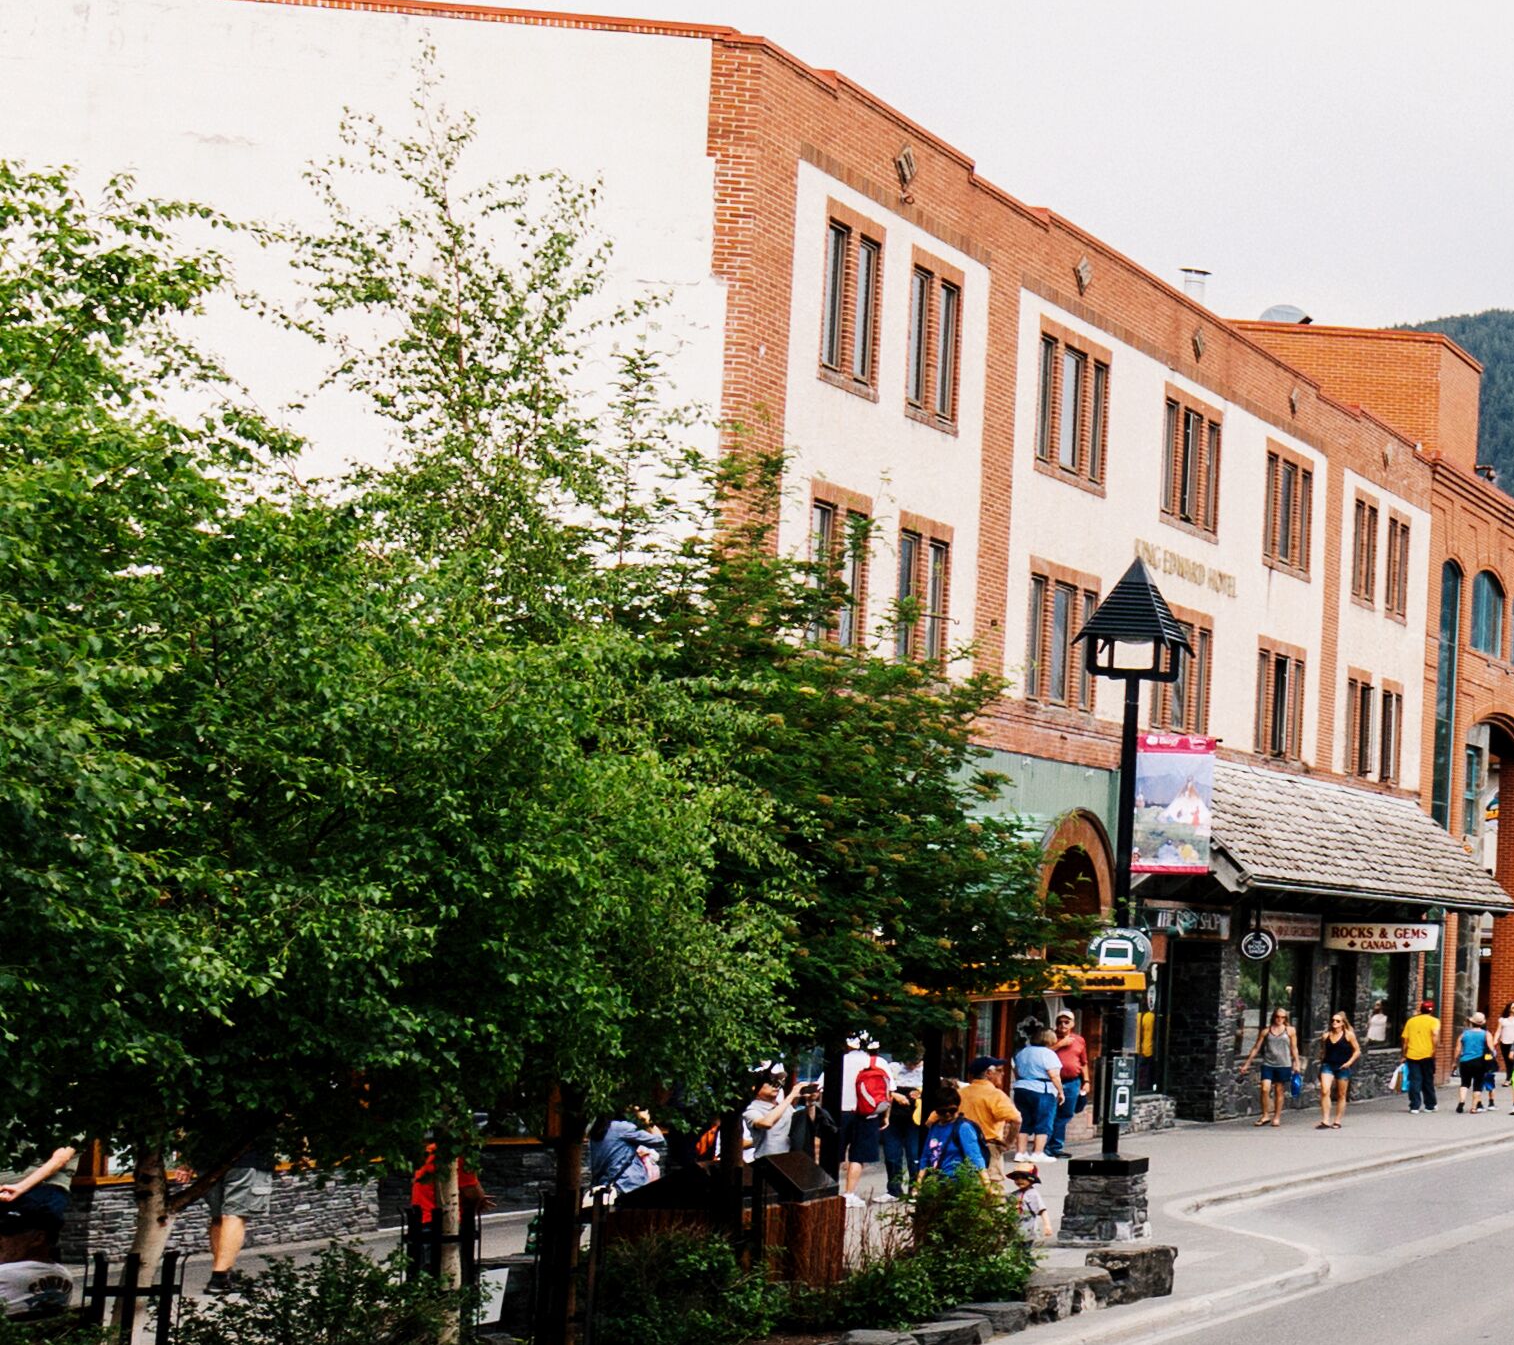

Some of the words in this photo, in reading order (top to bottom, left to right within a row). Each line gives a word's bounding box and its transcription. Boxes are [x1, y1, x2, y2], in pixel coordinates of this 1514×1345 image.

[1331, 926, 1374, 939] ROCKS
[1378, 927, 1389, 939] &
[1394, 927, 1429, 940] GEMS
[1360, 940, 1398, 950] CANADA
